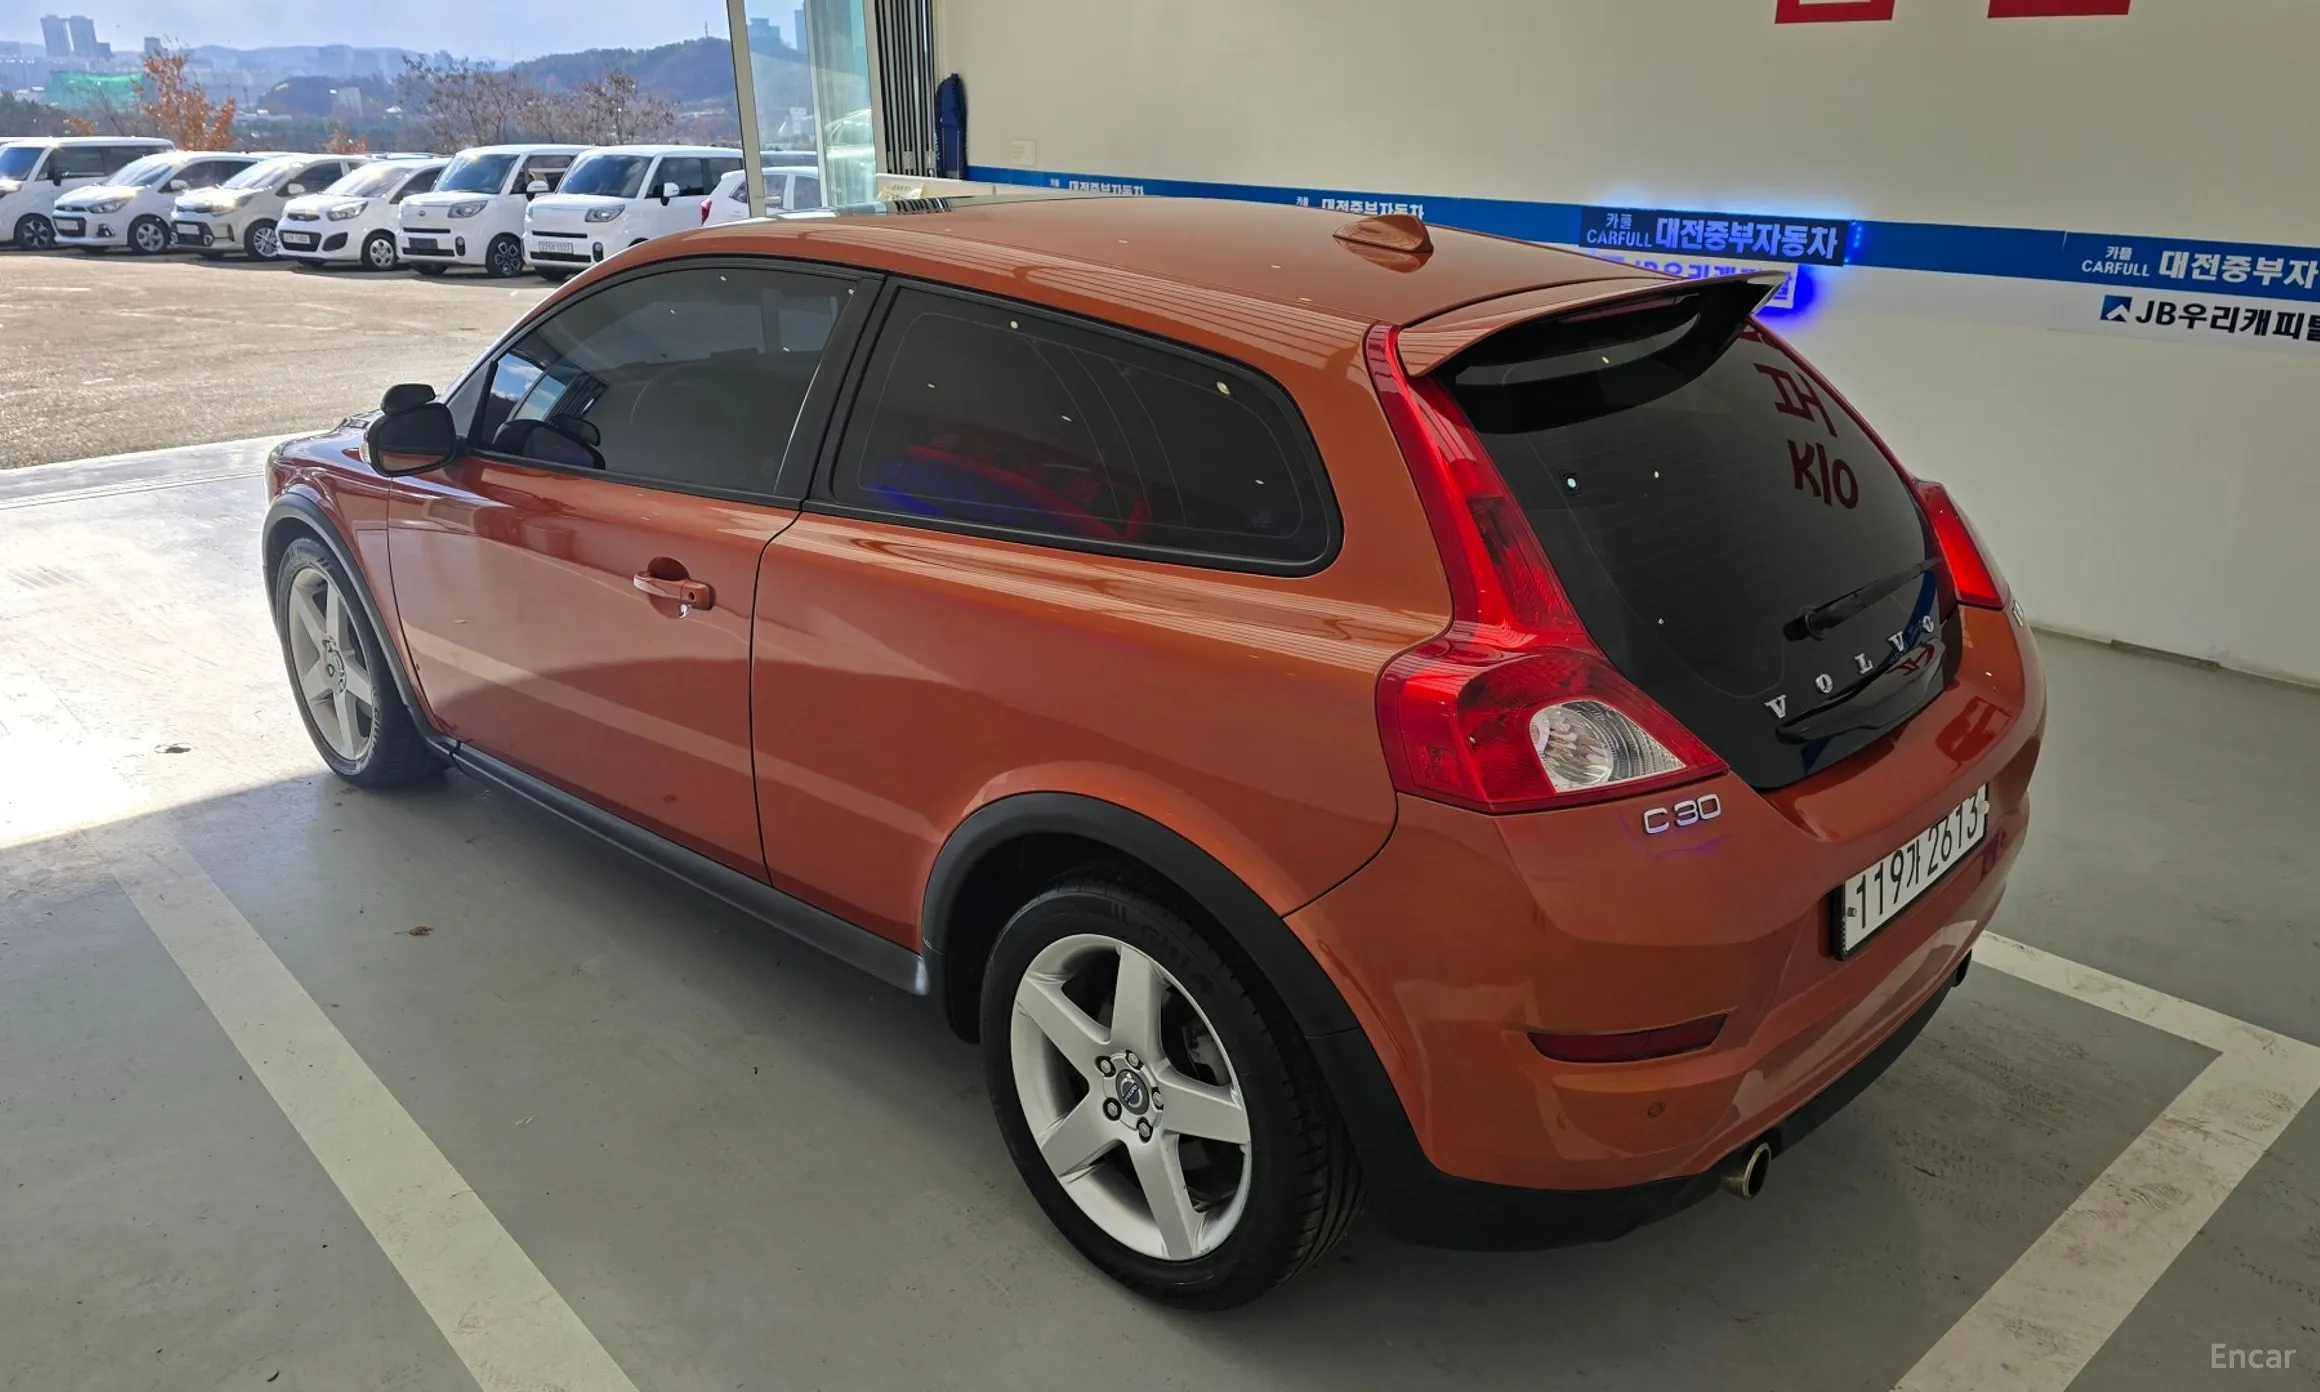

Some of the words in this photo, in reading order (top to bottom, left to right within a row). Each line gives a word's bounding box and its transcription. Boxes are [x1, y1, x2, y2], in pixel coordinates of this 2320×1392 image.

[1587, 229, 1653, 248] CARFULL
[1655, 217, 1838, 259] 대전중부자동차
[2082, 260, 2150, 277] CARFULL
[2159, 250, 2319, 290] 대전중부자
[1764, 615, 1935, 719] VOLVO
